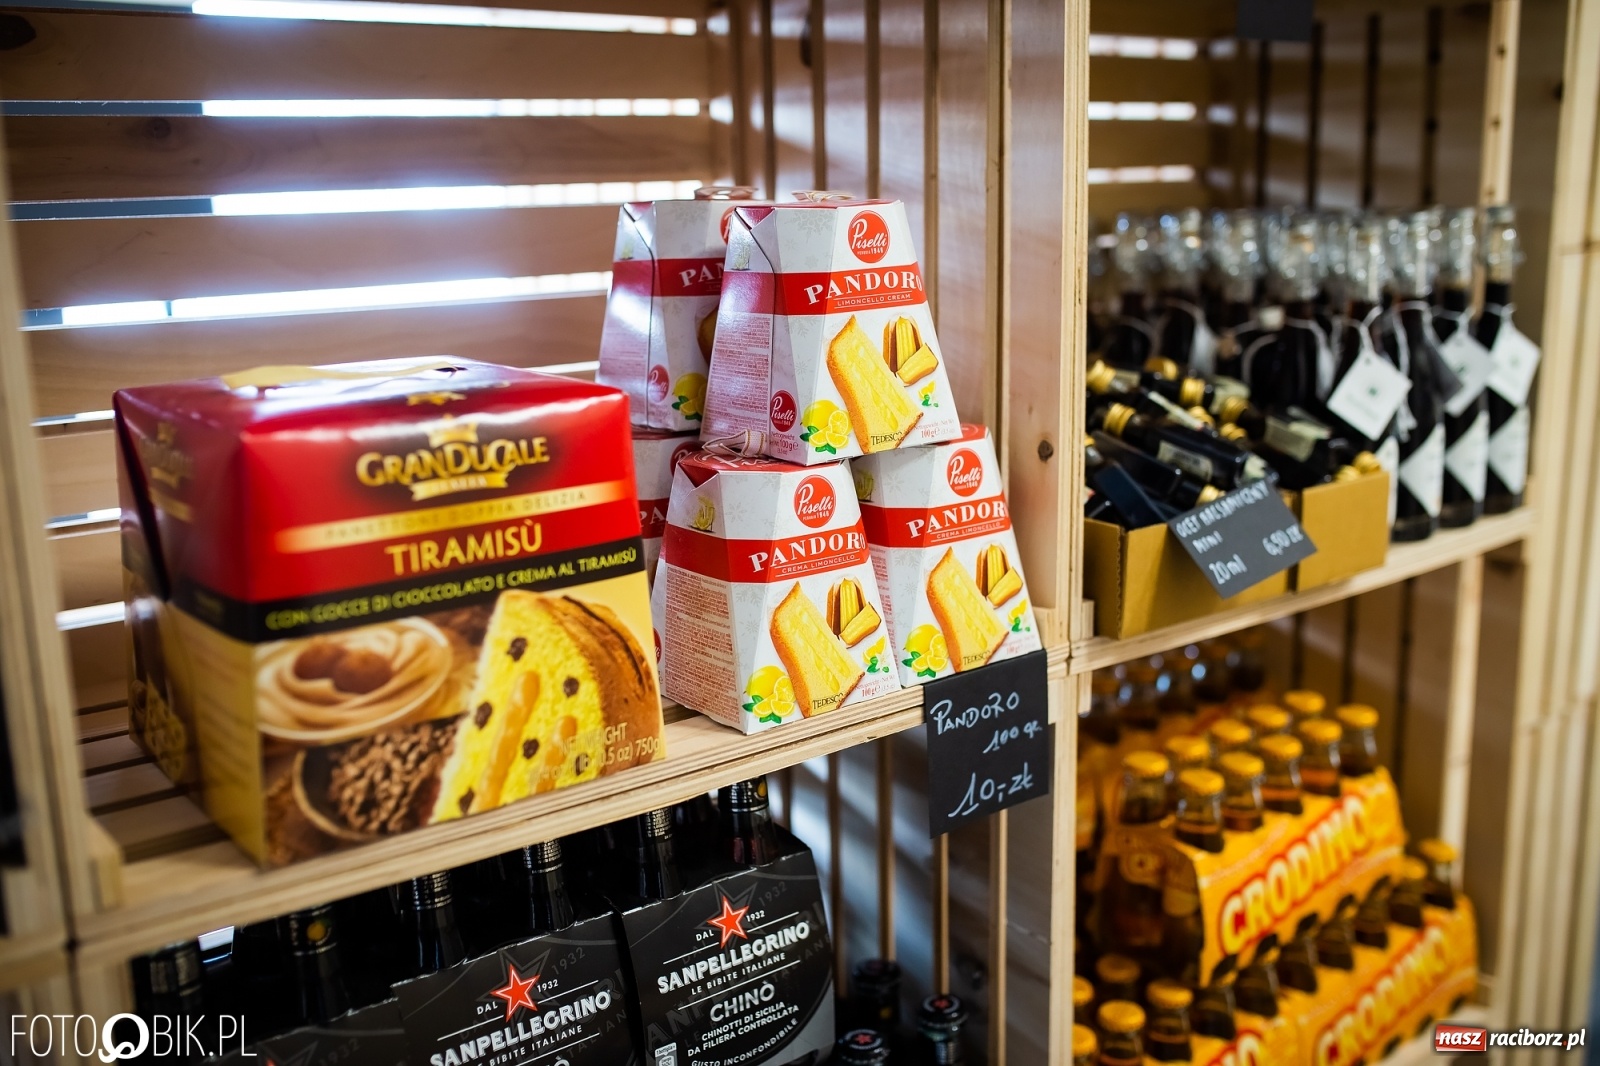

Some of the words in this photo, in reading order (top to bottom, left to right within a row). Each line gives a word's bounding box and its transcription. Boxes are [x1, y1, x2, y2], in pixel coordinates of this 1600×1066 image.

[851, 218, 888, 249] Piselli
[837, 296, 885, 307] LIMONCELLO
[887, 293, 911, 302] CREAM
[771, 396, 795, 420] Piselli
[950, 455, 982, 486] Piselli
[521, 489, 586, 512] DELIZIA
[798, 483, 834, 516] Piselli
[384, 519, 543, 576] TIRAMISÙ
[748, 532, 866, 573] PANDORO
[936, 531, 960, 539] CREMA
[496, 573, 505, 589] E
[507, 566, 557, 587] CREMA
[557, 561, 576, 578] AL
[579, 546, 637, 572] TIRAMISÙ
[782, 564, 808, 574] CREMA
[811, 554, 855, 569] LIMONCELLO
[930, 692, 1020, 735] PANDORO
[635, 736, 659, 758] 750g
[1221, 795, 1370, 955] CRODINO
[695, 929, 715, 942] DAL
[746, 910, 766, 923] 1932
[657, 921, 810, 994] SANPELLEGRINO
[691, 985, 703, 996] LE
[706, 971, 738, 990] BIBITE
[742, 952, 786, 976] ITALIANE
[476, 1000, 499, 1016] DAL
[537, 979, 559, 993] 1932
[709, 980, 776, 1022] CHINÒ
[430, 990, 612, 1066] SANPELLEGRINO
[687, 1046, 701, 1057] DA
[702, 1032, 736, 1052] FILIERA
[737, 1004, 800, 1035] CONTROLLATA
[701, 1018, 743, 1042] CHINOTTI
[744, 1013, 754, 1024] DI
[755, 1001, 786, 1019] SICILIA
[723, 1017, 799, 1066] INCONFONDIBILE
[489, 1046, 526, 1066] BIBITE
[531, 1024, 583, 1051] ITALIANE
